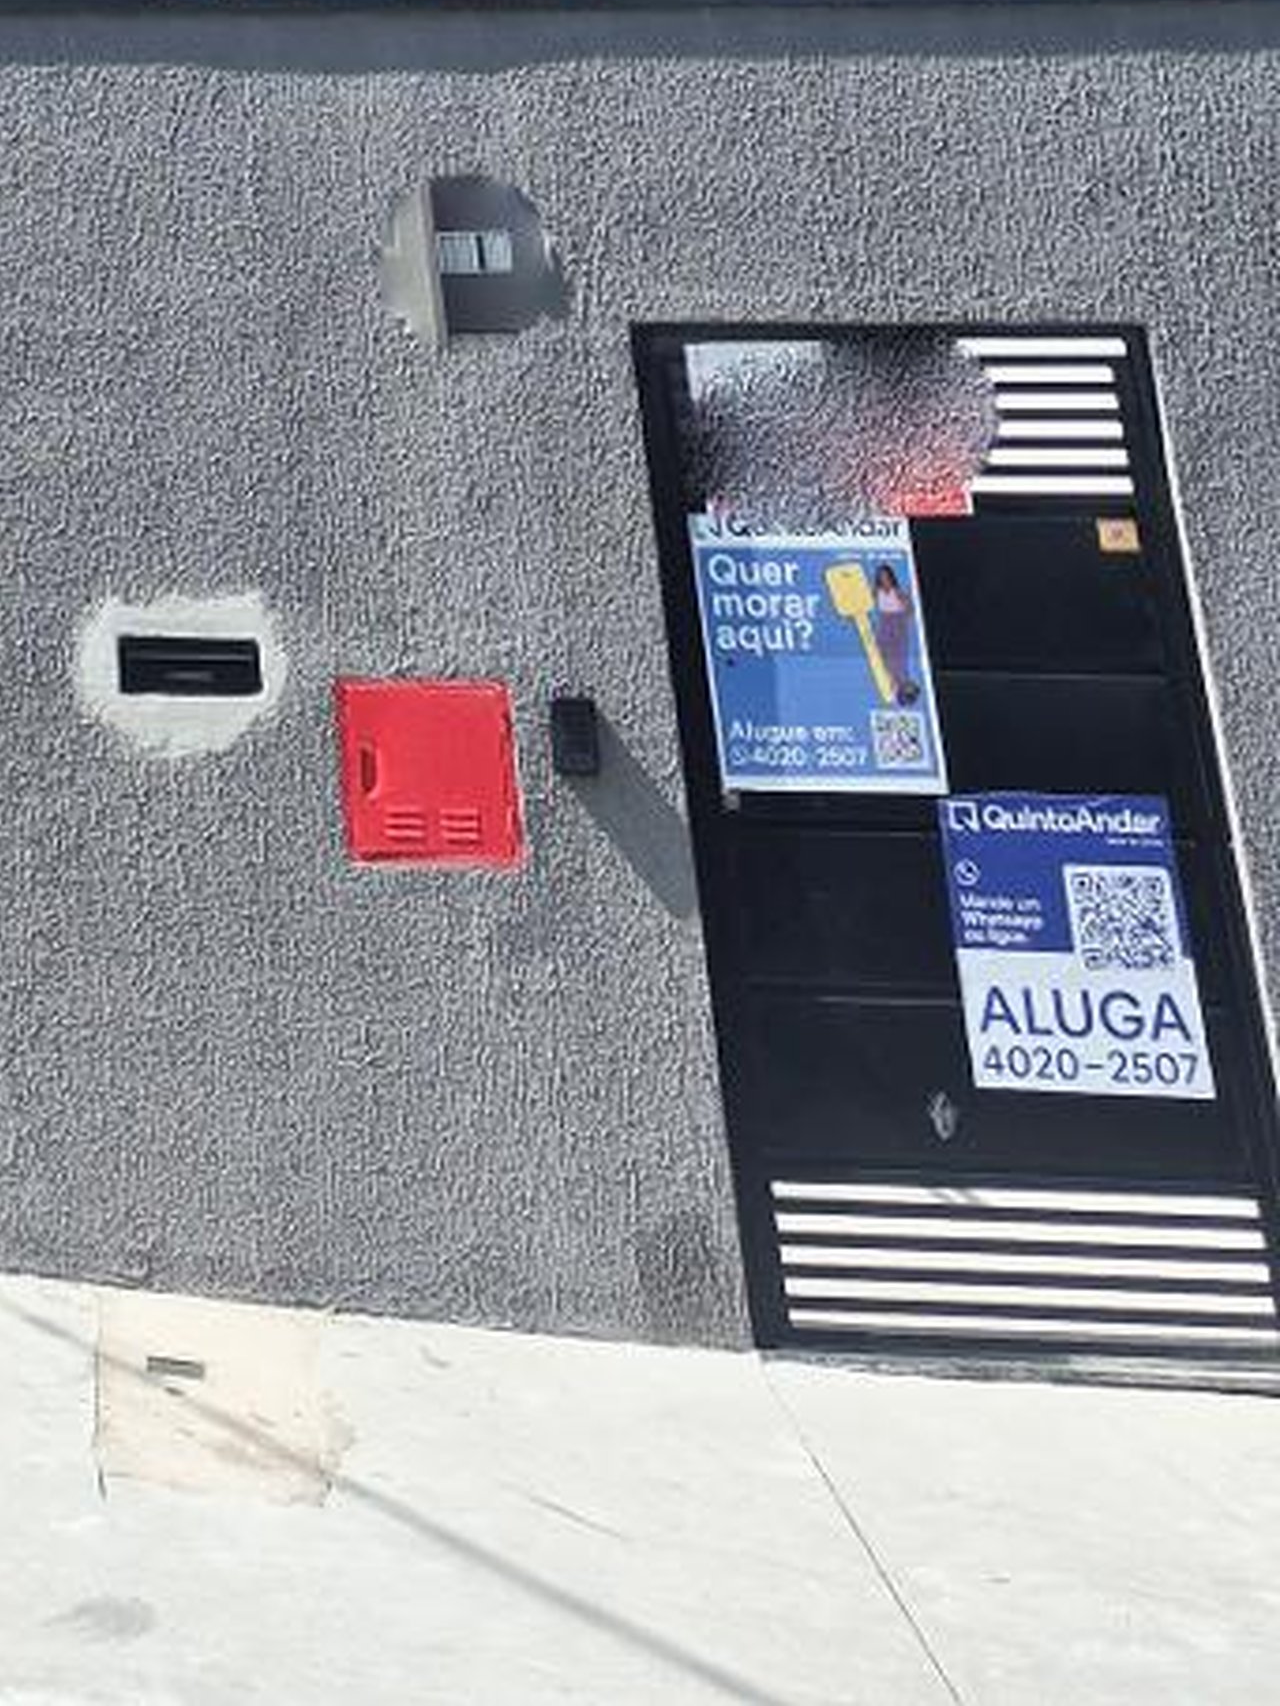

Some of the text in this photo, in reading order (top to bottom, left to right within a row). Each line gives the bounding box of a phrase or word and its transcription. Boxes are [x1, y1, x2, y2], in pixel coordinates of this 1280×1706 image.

[708, 553, 800, 586] Quer
[713, 592, 820, 618] morar
[716, 618, 814, 657] aqui?
[981, 803, 1161, 834] QuintoAndar
[981, 986, 1190, 1041] ALUGA
[984, 1045, 1198, 1085] 4020-2507
